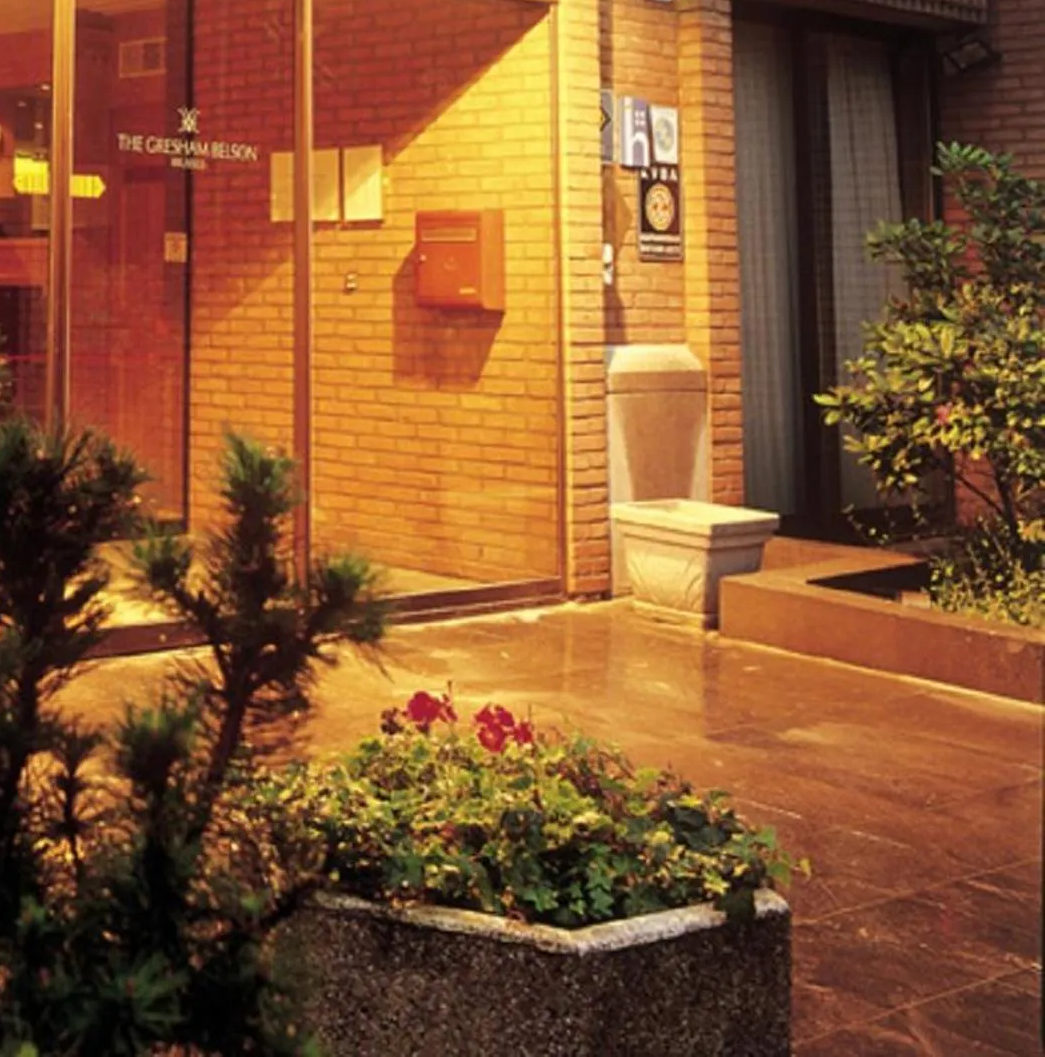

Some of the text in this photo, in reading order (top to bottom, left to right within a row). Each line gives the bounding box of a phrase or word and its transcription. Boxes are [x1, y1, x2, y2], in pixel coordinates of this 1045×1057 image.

[117, 132, 259, 162] THE GRESHAM BELSON
